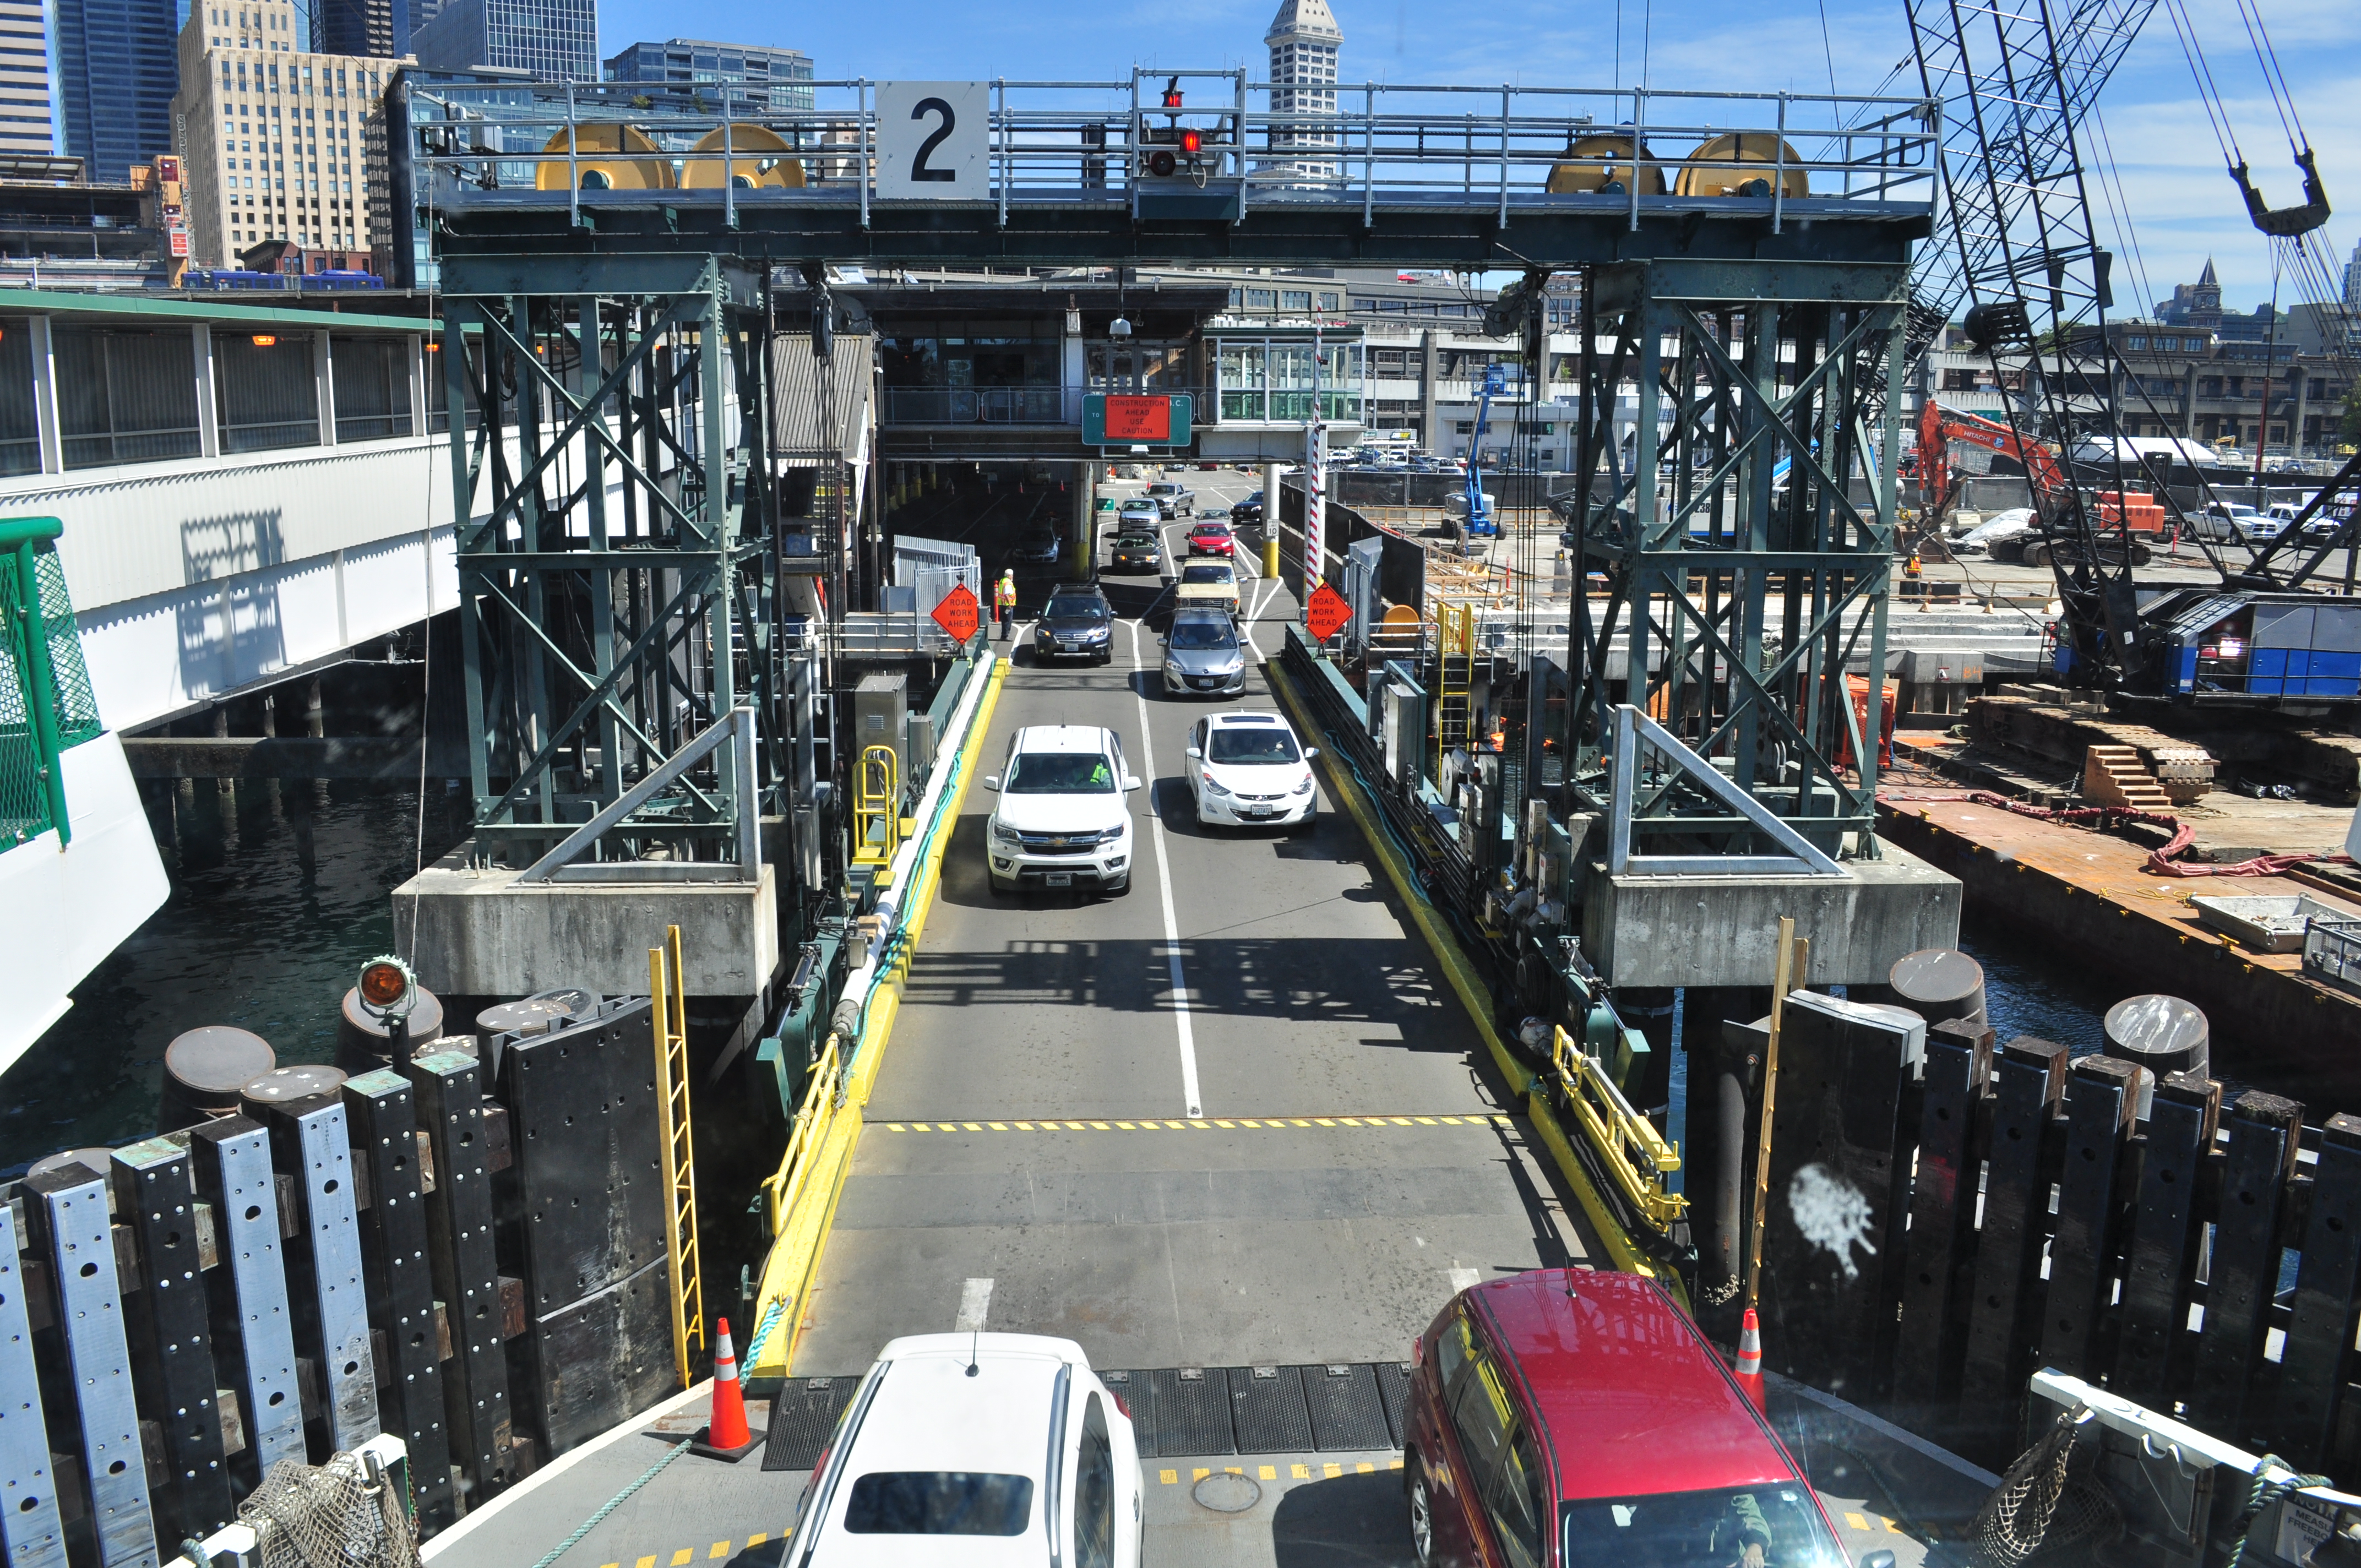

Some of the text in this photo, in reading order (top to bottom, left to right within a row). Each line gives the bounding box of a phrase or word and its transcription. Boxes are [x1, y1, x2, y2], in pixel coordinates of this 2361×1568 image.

[911, 97, 956, 182] 2
[1963, 431, 1990, 442] HITACHI
[2288, 1516, 2329, 1540] FREEBO
[2295, 1510, 2332, 1533] MEASU
